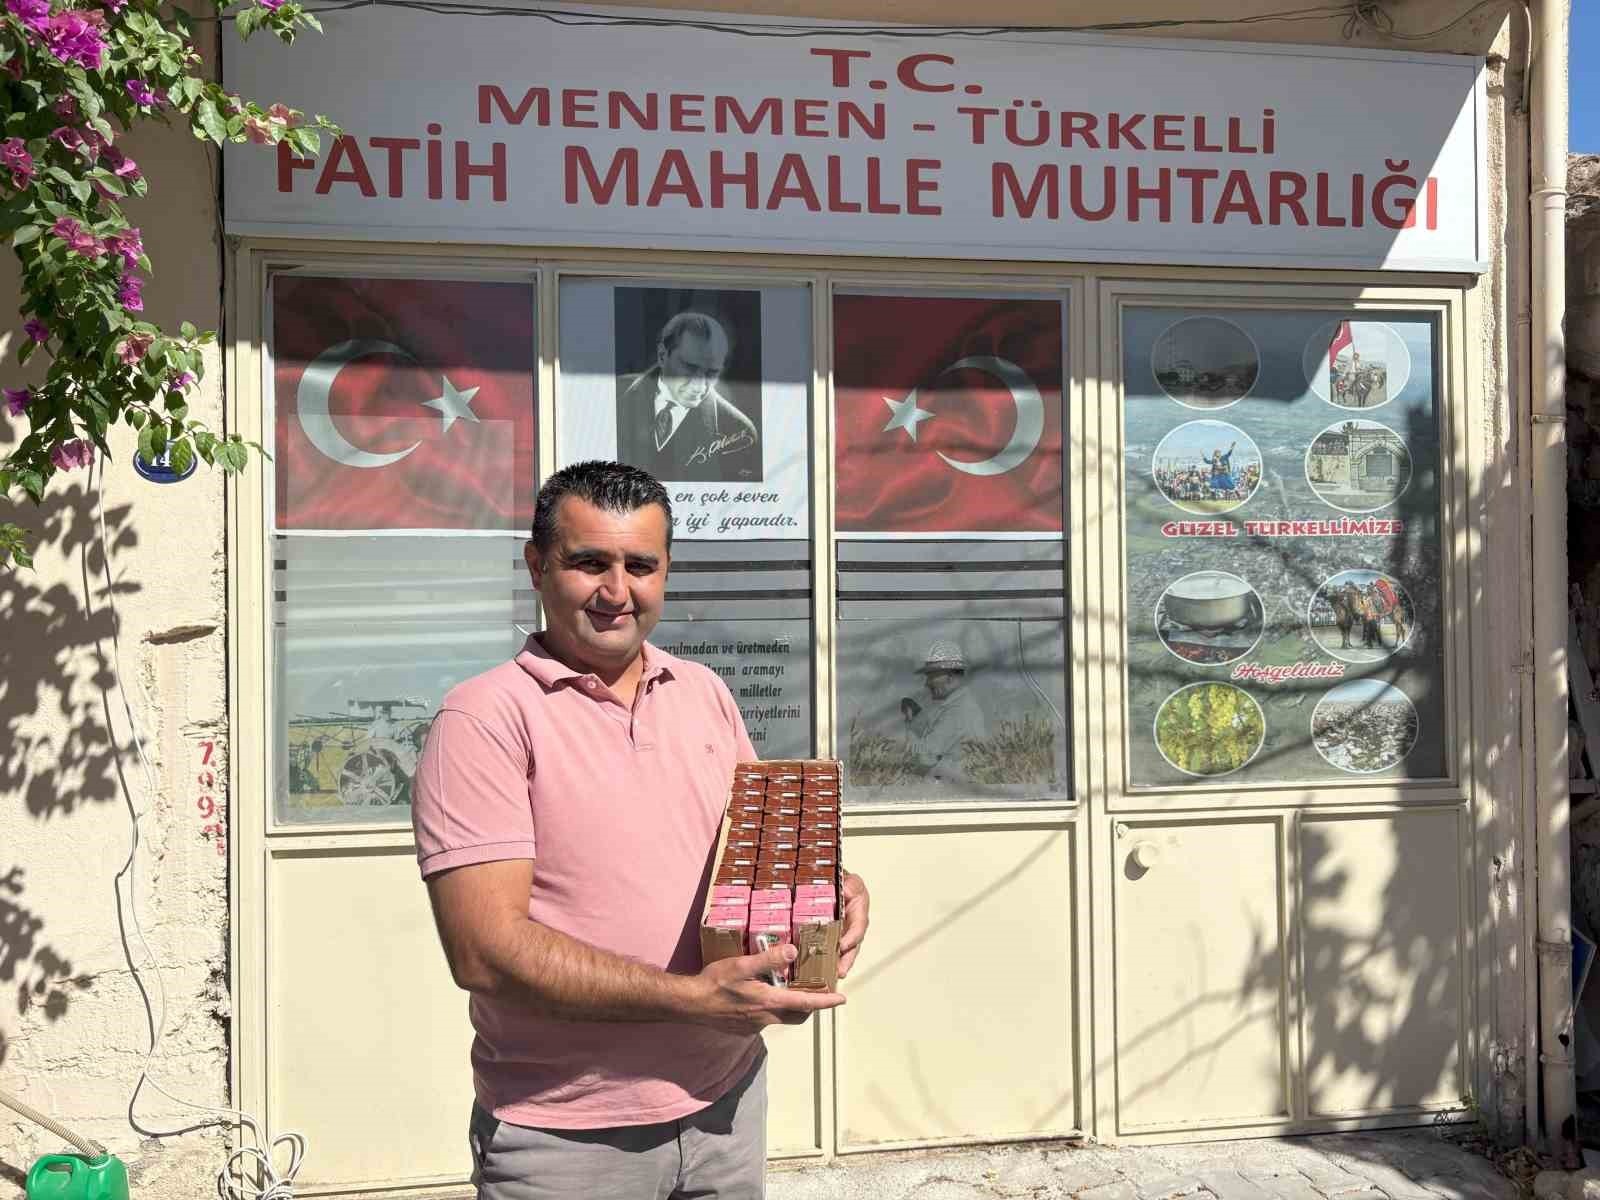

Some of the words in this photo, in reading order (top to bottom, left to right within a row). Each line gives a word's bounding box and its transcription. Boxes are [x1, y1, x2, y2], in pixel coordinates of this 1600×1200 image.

[810, 48, 983, 94] T.C.
[478, 85, 886, 140] MENEMEN
[957, 99, 1276, 154] TÜRKELLİ
[277, 123, 507, 202] FATİH
[564, 145, 943, 217] MAHALLE
[992, 158, 1438, 231] MUHTARLIĞI
[675, 492, 695, 503] en
[701, 489, 730, 506] çok
[733, 491, 781, 503] seven
[722, 643, 734, 655] ve
[740, 684, 782, 697] milletler
